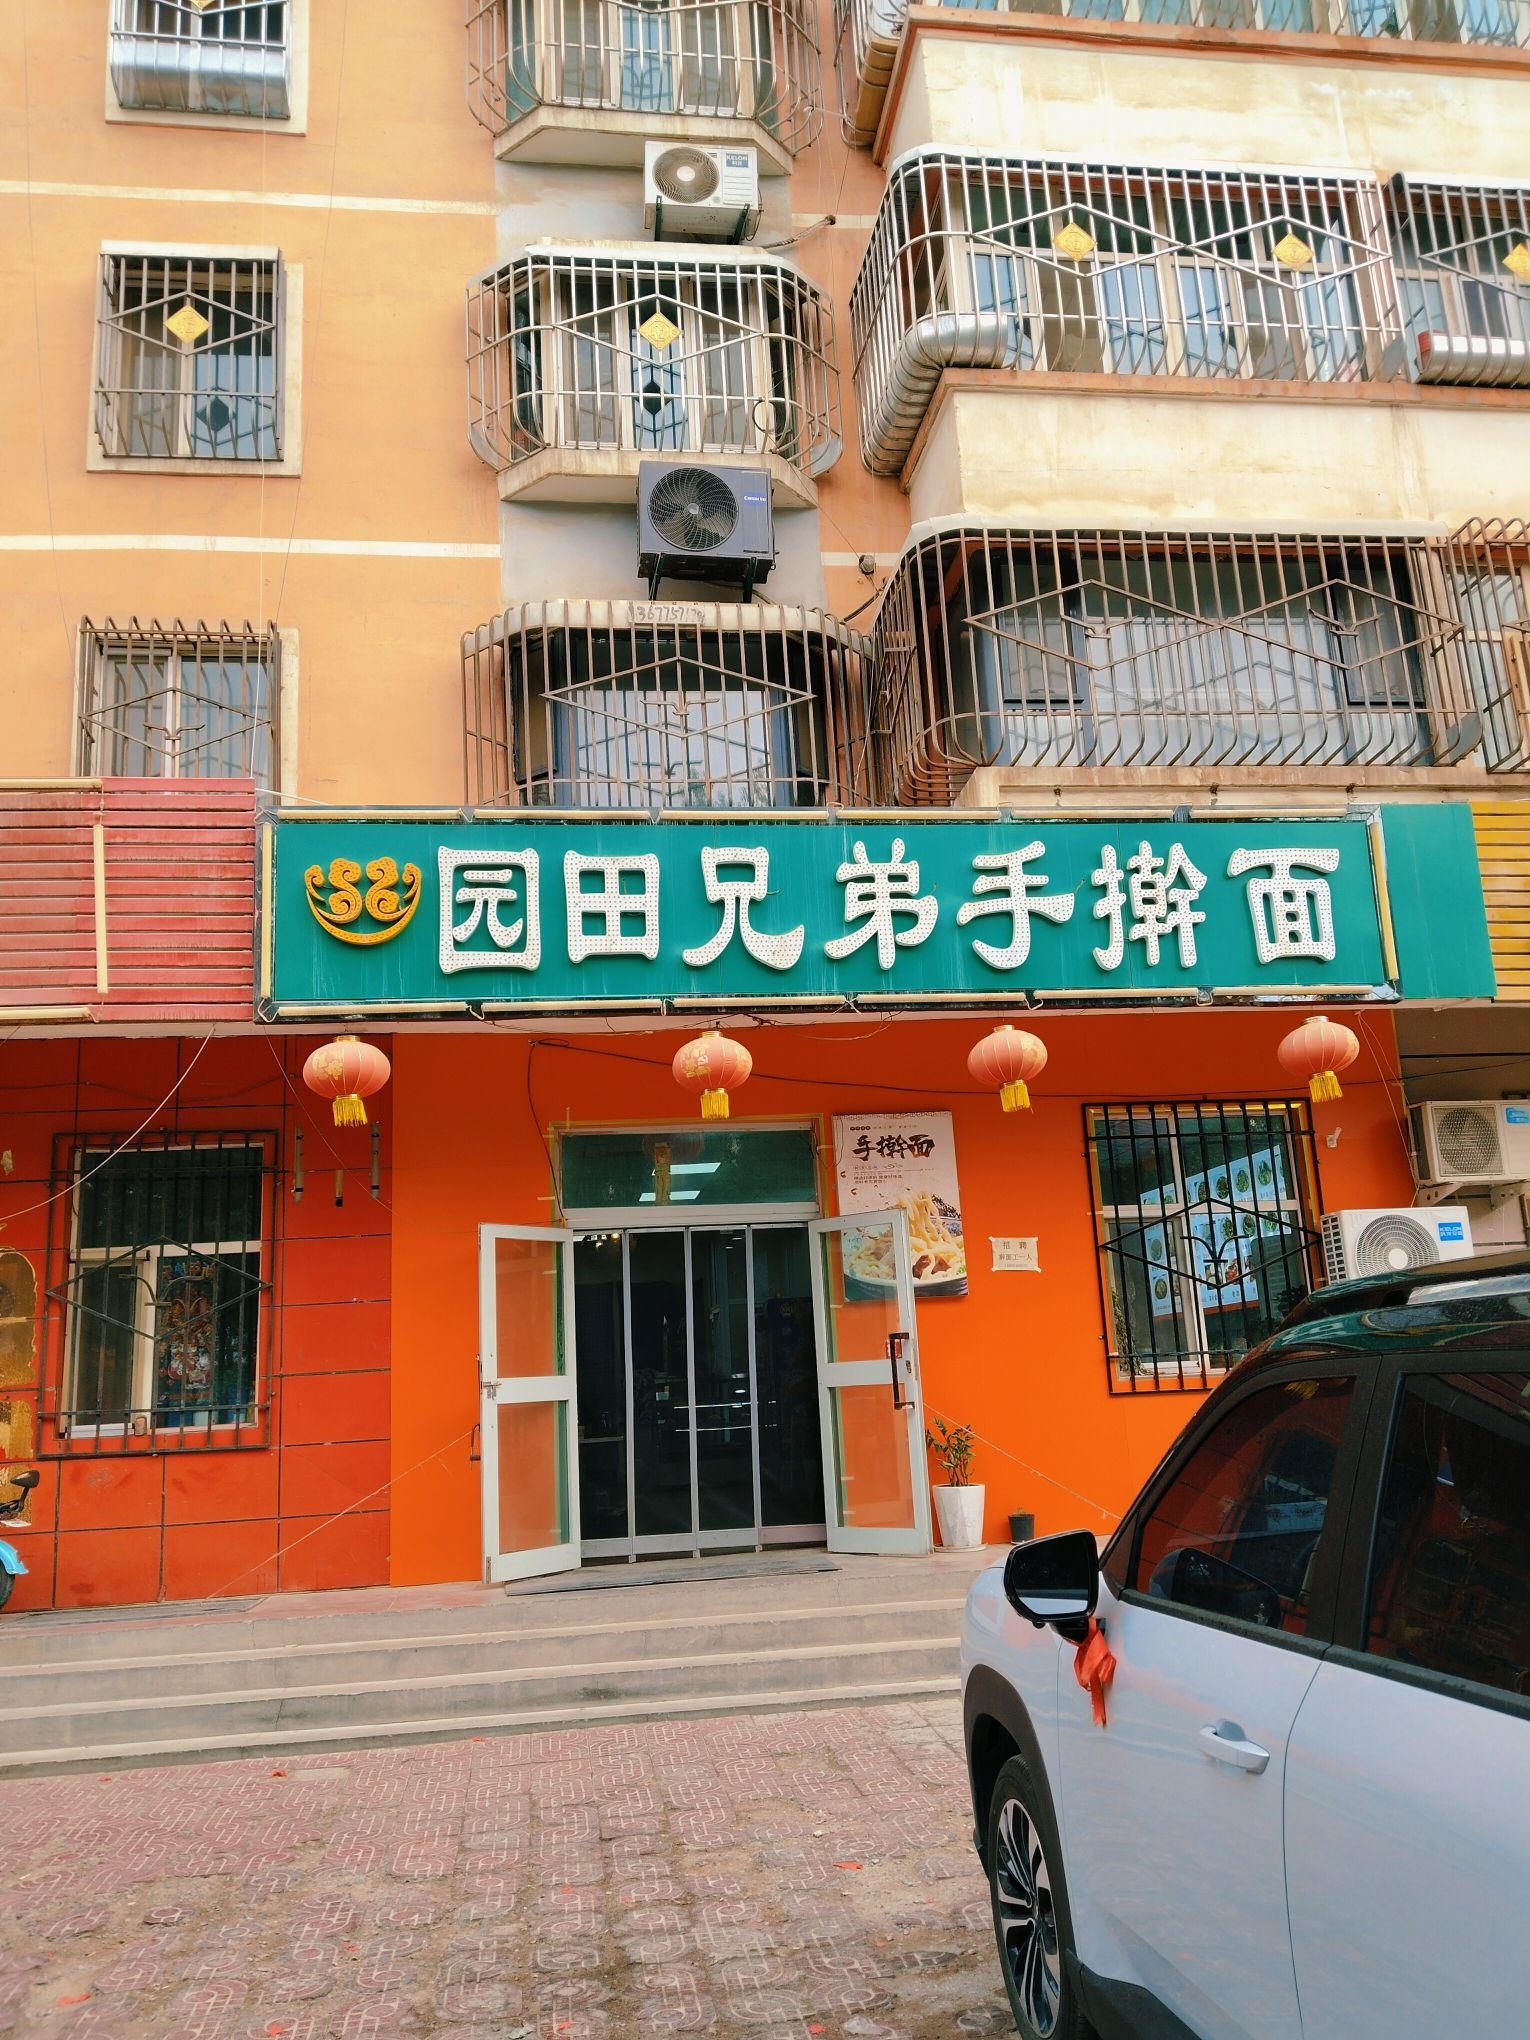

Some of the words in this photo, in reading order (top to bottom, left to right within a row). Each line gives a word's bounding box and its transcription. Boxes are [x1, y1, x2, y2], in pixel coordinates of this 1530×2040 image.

[438, 837, 1340, 974] 园田兄弟手擀面
[852, 1134, 936, 1162] 手擀面
